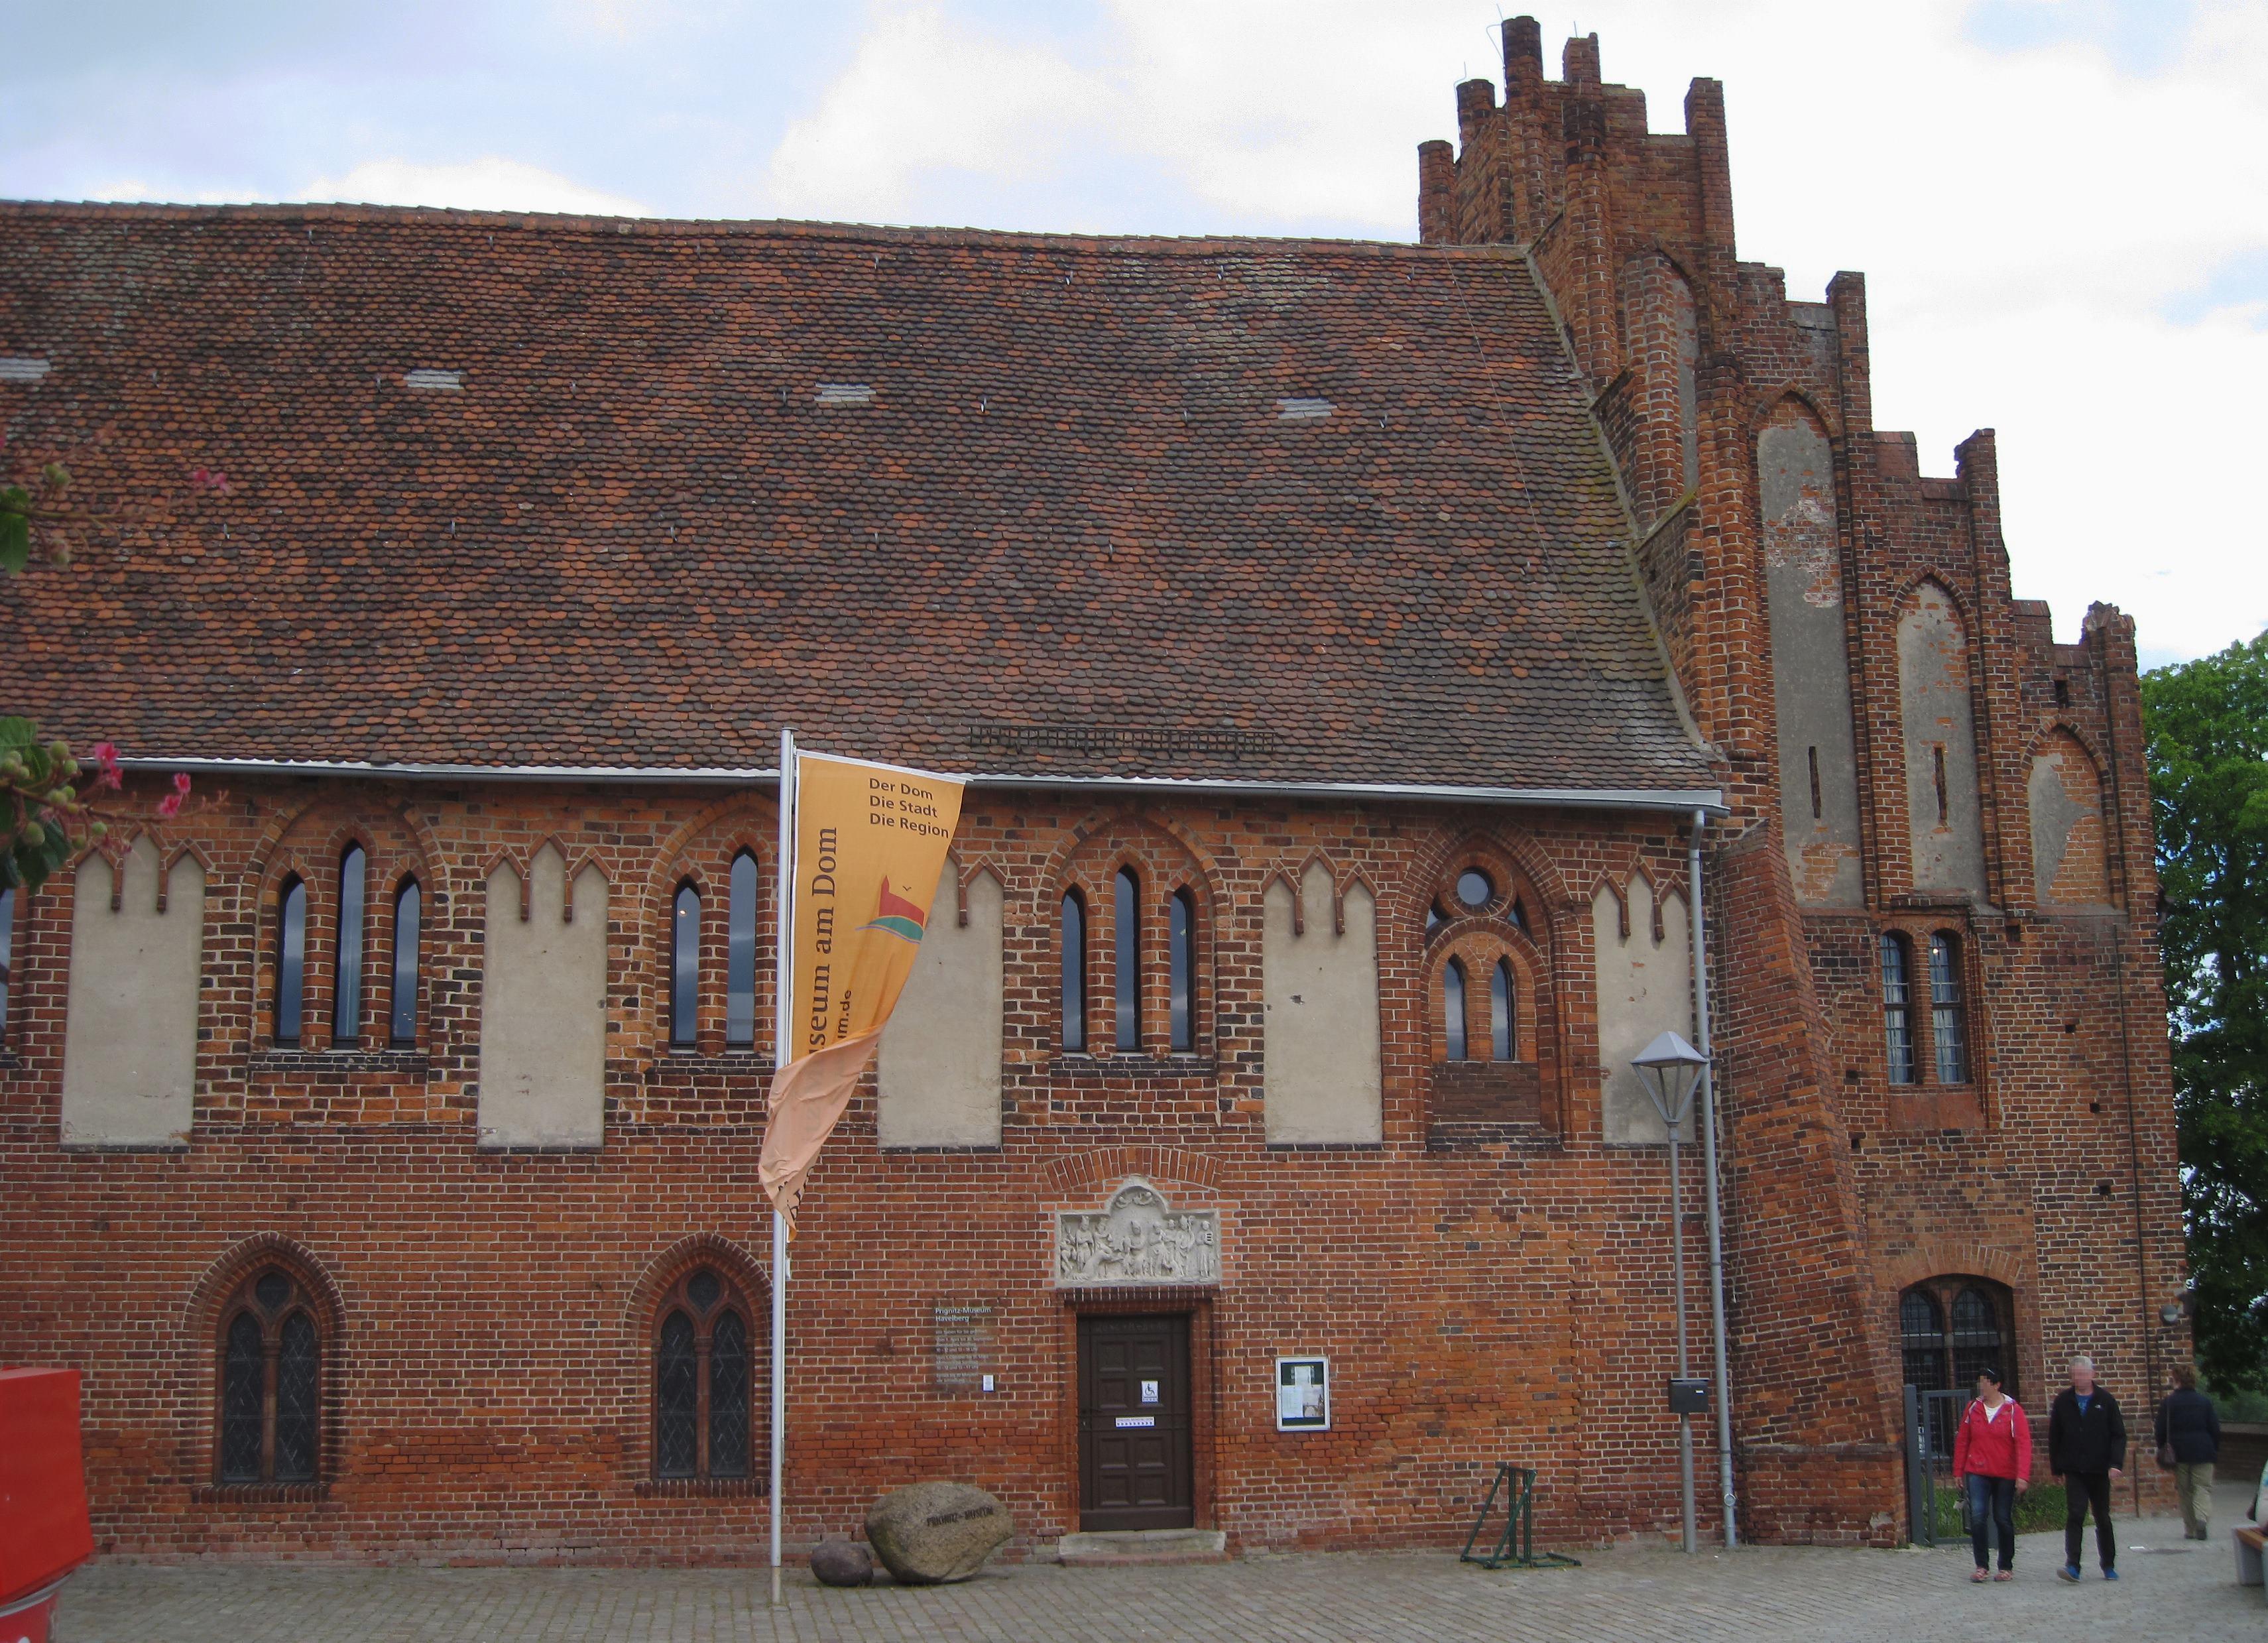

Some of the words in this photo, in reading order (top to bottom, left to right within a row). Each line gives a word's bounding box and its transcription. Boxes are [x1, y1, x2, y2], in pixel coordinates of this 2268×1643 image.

[869, 778, 895, 792] Der
[900, 783, 933, 800] Dom
[870, 795, 894, 809] Die
[899, 800, 937, 818] Stadt
[870, 813, 895, 827] Die
[900, 817, 949, 839] Region
[811, 827, 837, 897] Dom
[815, 906, 834, 955] am
[935, 1314, 970, 1323] Havelberg
